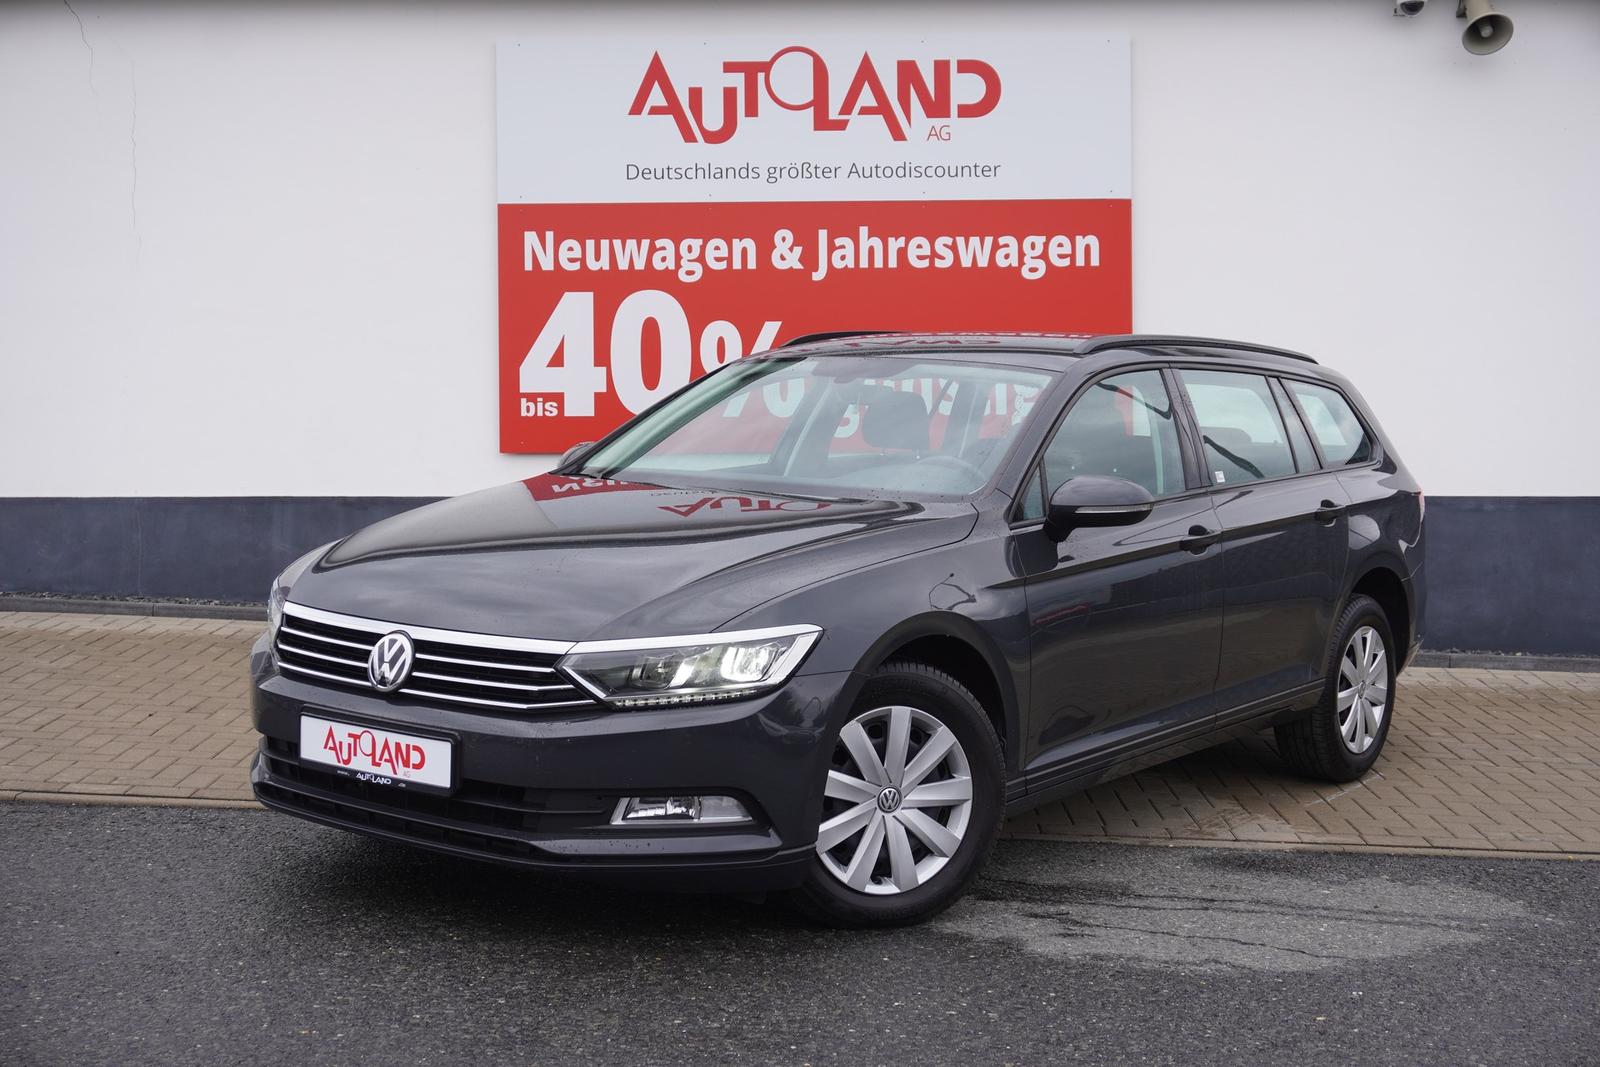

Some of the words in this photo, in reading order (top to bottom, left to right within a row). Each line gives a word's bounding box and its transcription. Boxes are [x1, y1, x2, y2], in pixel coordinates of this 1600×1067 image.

[628, 45, 1002, 145] AUTOLAND
[926, 124, 951, 141] AG
[625, 163, 761, 181] Deutschlands
[766, 162, 841, 184] größter
[847, 162, 1001, 179] Autodiscounter
[523, 230, 757, 283] Neuwagen
[771, 228, 804, 270] &
[811, 226, 1101, 281] Jahreswagen
[520, 398, 558, 417] bis
[323, 725, 426, 776] AUTOLAND
